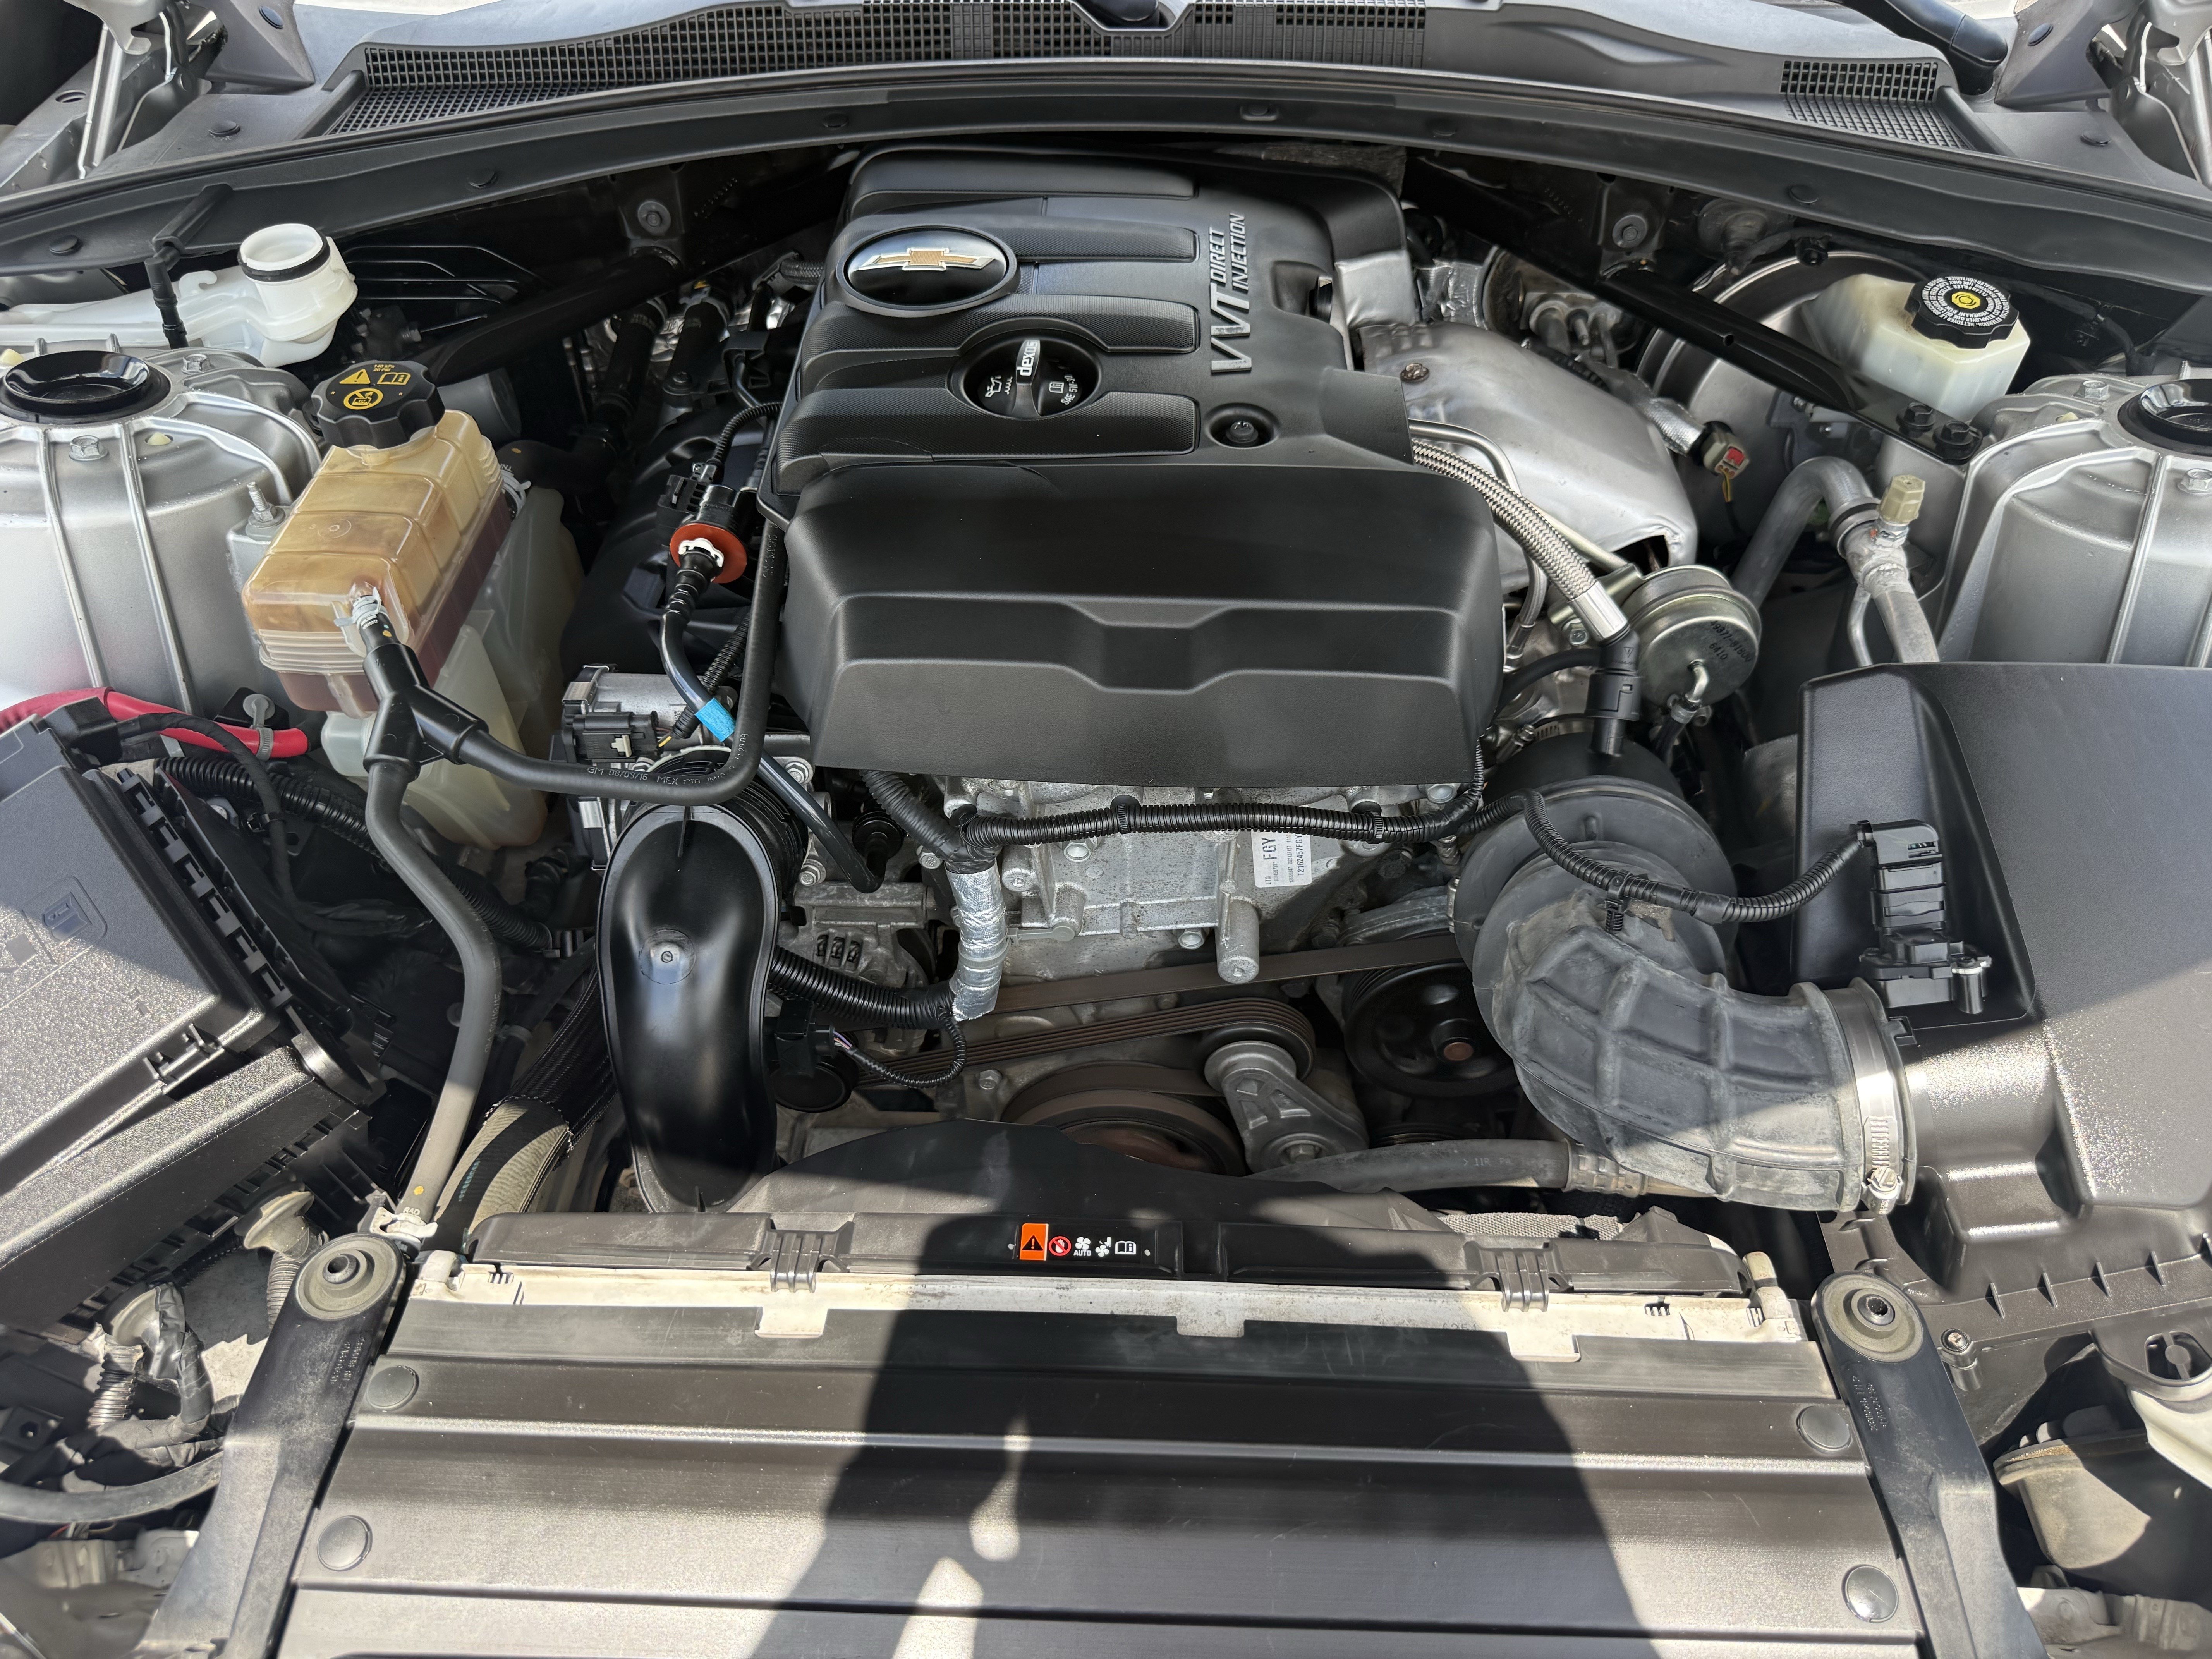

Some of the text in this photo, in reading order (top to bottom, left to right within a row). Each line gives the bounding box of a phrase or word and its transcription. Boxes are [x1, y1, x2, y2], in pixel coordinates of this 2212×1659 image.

[1209, 227, 1226, 283] DIRECT
[1229, 213, 1249, 290] INJECTION
[1211, 283, 1252, 372] VVT
[1017, 341, 1038, 376] dexos
[1061, 374, 1078, 405] SAE 5W-30
[587, 766, 604, 775] GM
[657, 775, 678, 785] MEX
[1261, 837, 1277, 860] FGY
[1295, 834, 1305, 876] T2162457FGY
[403, 1207, 421, 1216] RAD
